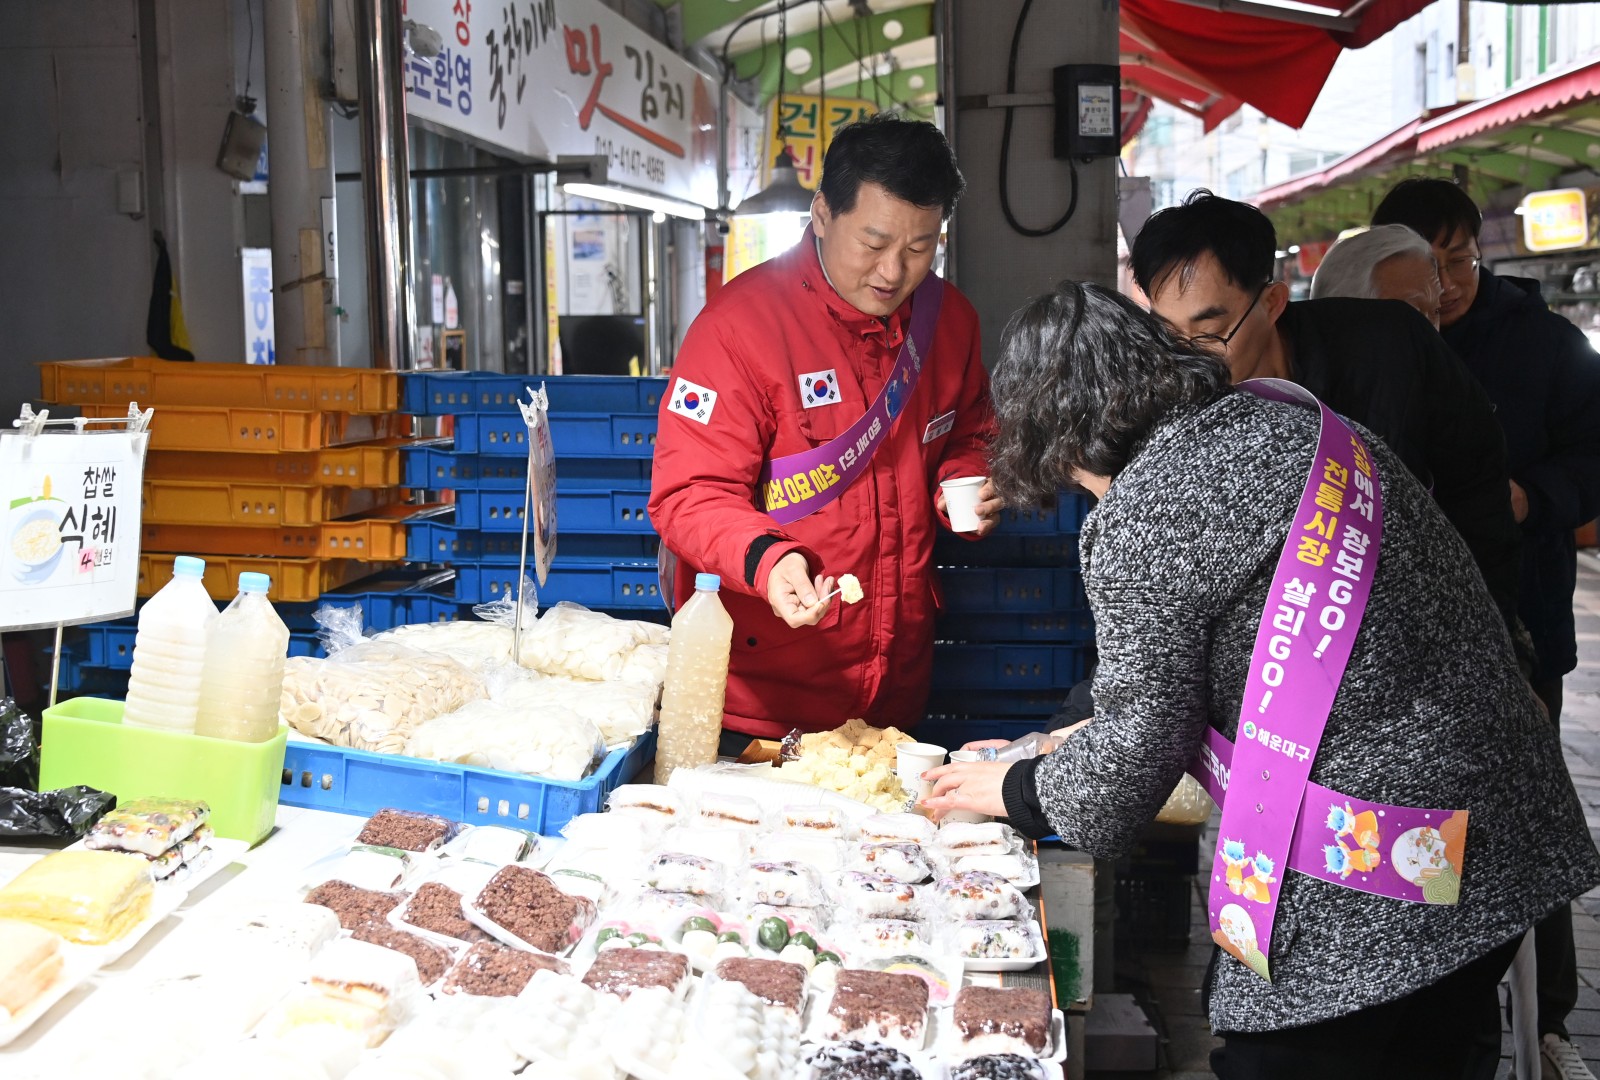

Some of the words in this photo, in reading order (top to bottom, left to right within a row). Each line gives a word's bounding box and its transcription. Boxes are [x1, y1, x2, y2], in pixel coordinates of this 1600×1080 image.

[624, 44, 684, 121] 김치
[83, 466, 117, 499] 찹쌀
[762, 463, 841, 512] 설명절
[1296, 457, 1348, 567] 전통시장
[58, 503, 116, 553] 식혜
[1313, 524, 1371, 658] 장보GO!
[1258, 577, 1317, 713] 살리GO!
[1257, 727, 1311, 762] 해운대구
